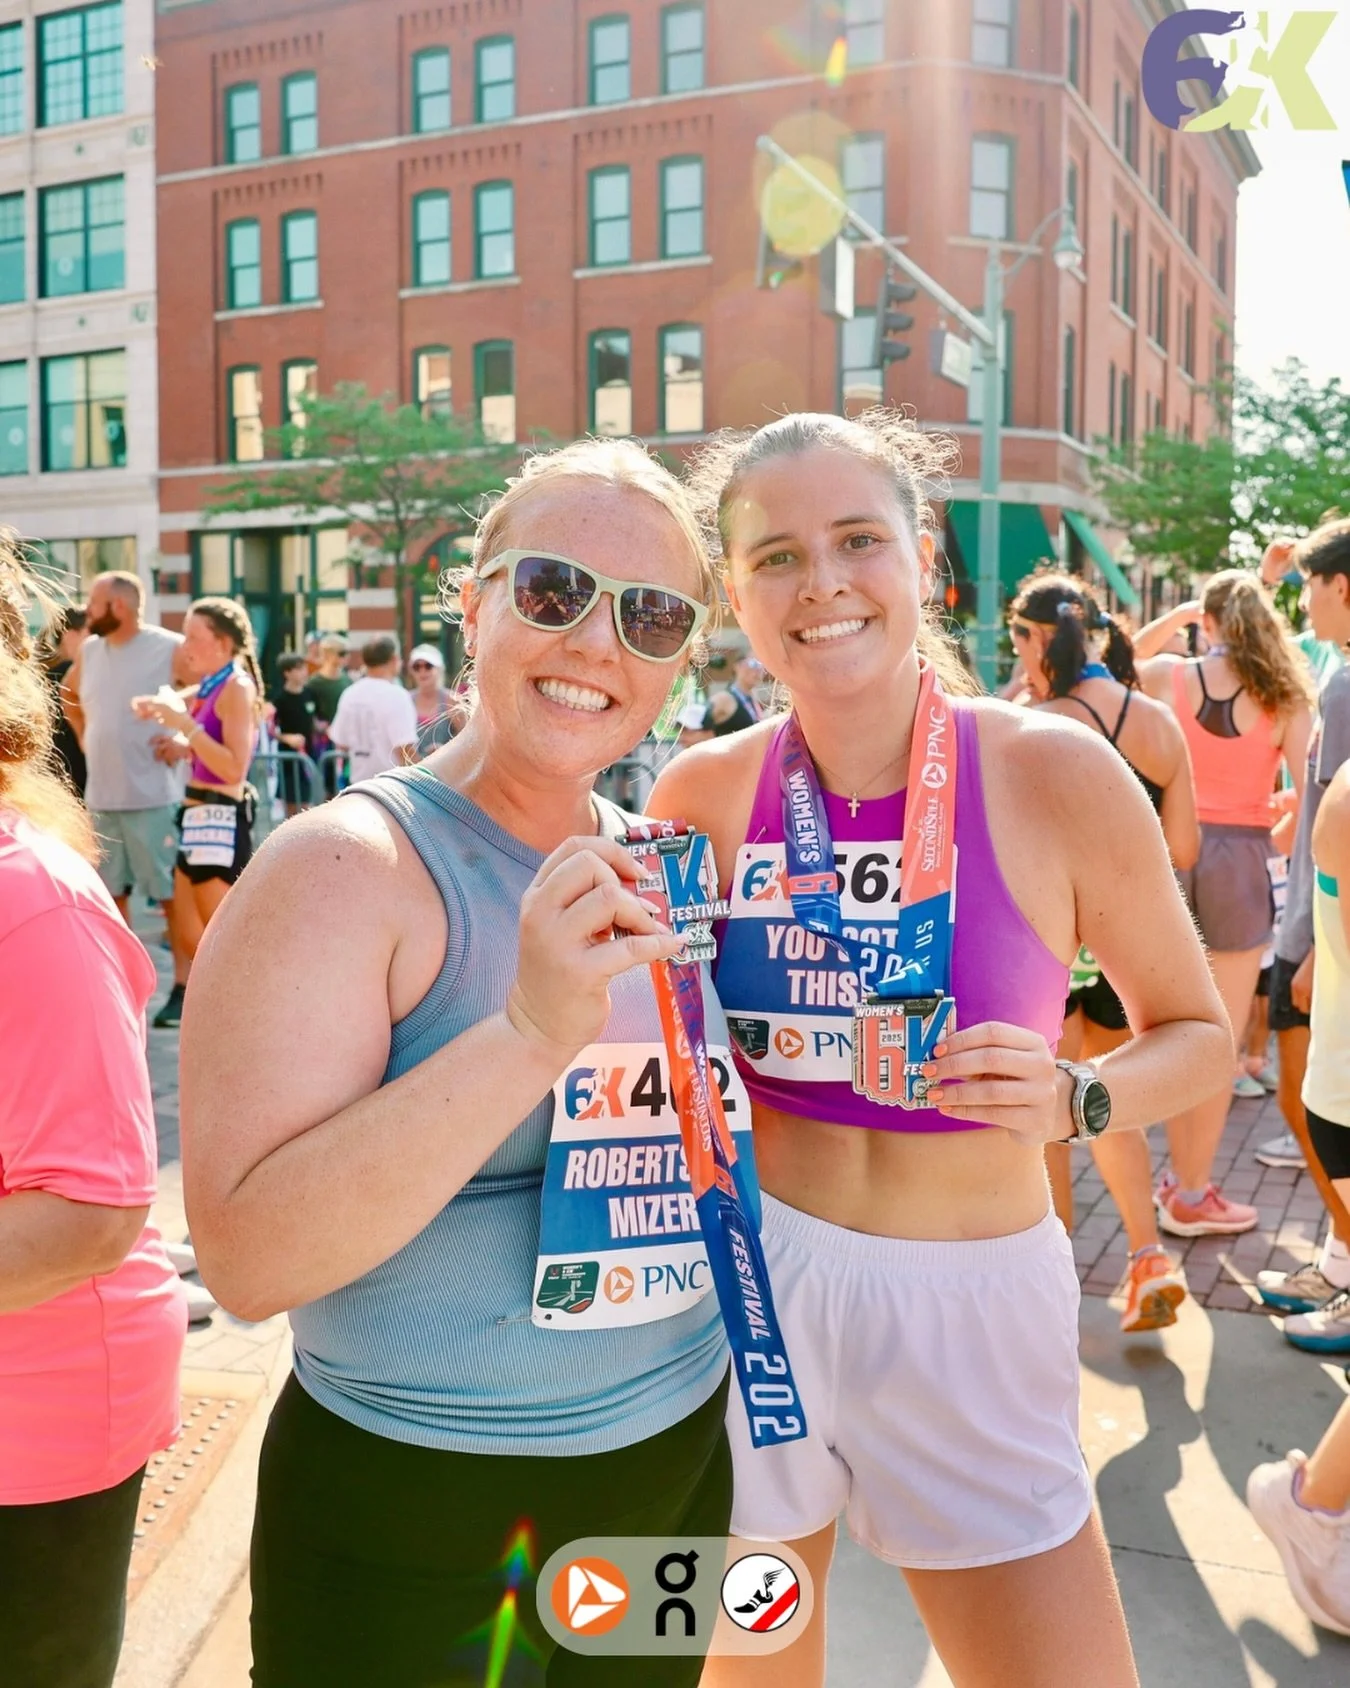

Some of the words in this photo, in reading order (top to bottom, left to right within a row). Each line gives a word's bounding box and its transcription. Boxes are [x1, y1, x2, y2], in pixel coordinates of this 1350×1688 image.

[926, 705, 947, 759] PNC
[787, 770, 821, 865] WOMEN'S
[669, 900, 732, 922] FESTIVAL
[915, 918, 935, 949] US
[855, 1005, 905, 1018] WOMEN'S
[810, 1030, 853, 1058] PN
[881, 1033, 903, 1043] 2025
[630, 1057, 737, 1117] 42
[641, 1260, 709, 1298] PNC
[728, 1227, 771, 1340] FESTIVAL
[744, 1351, 802, 1439] 202
